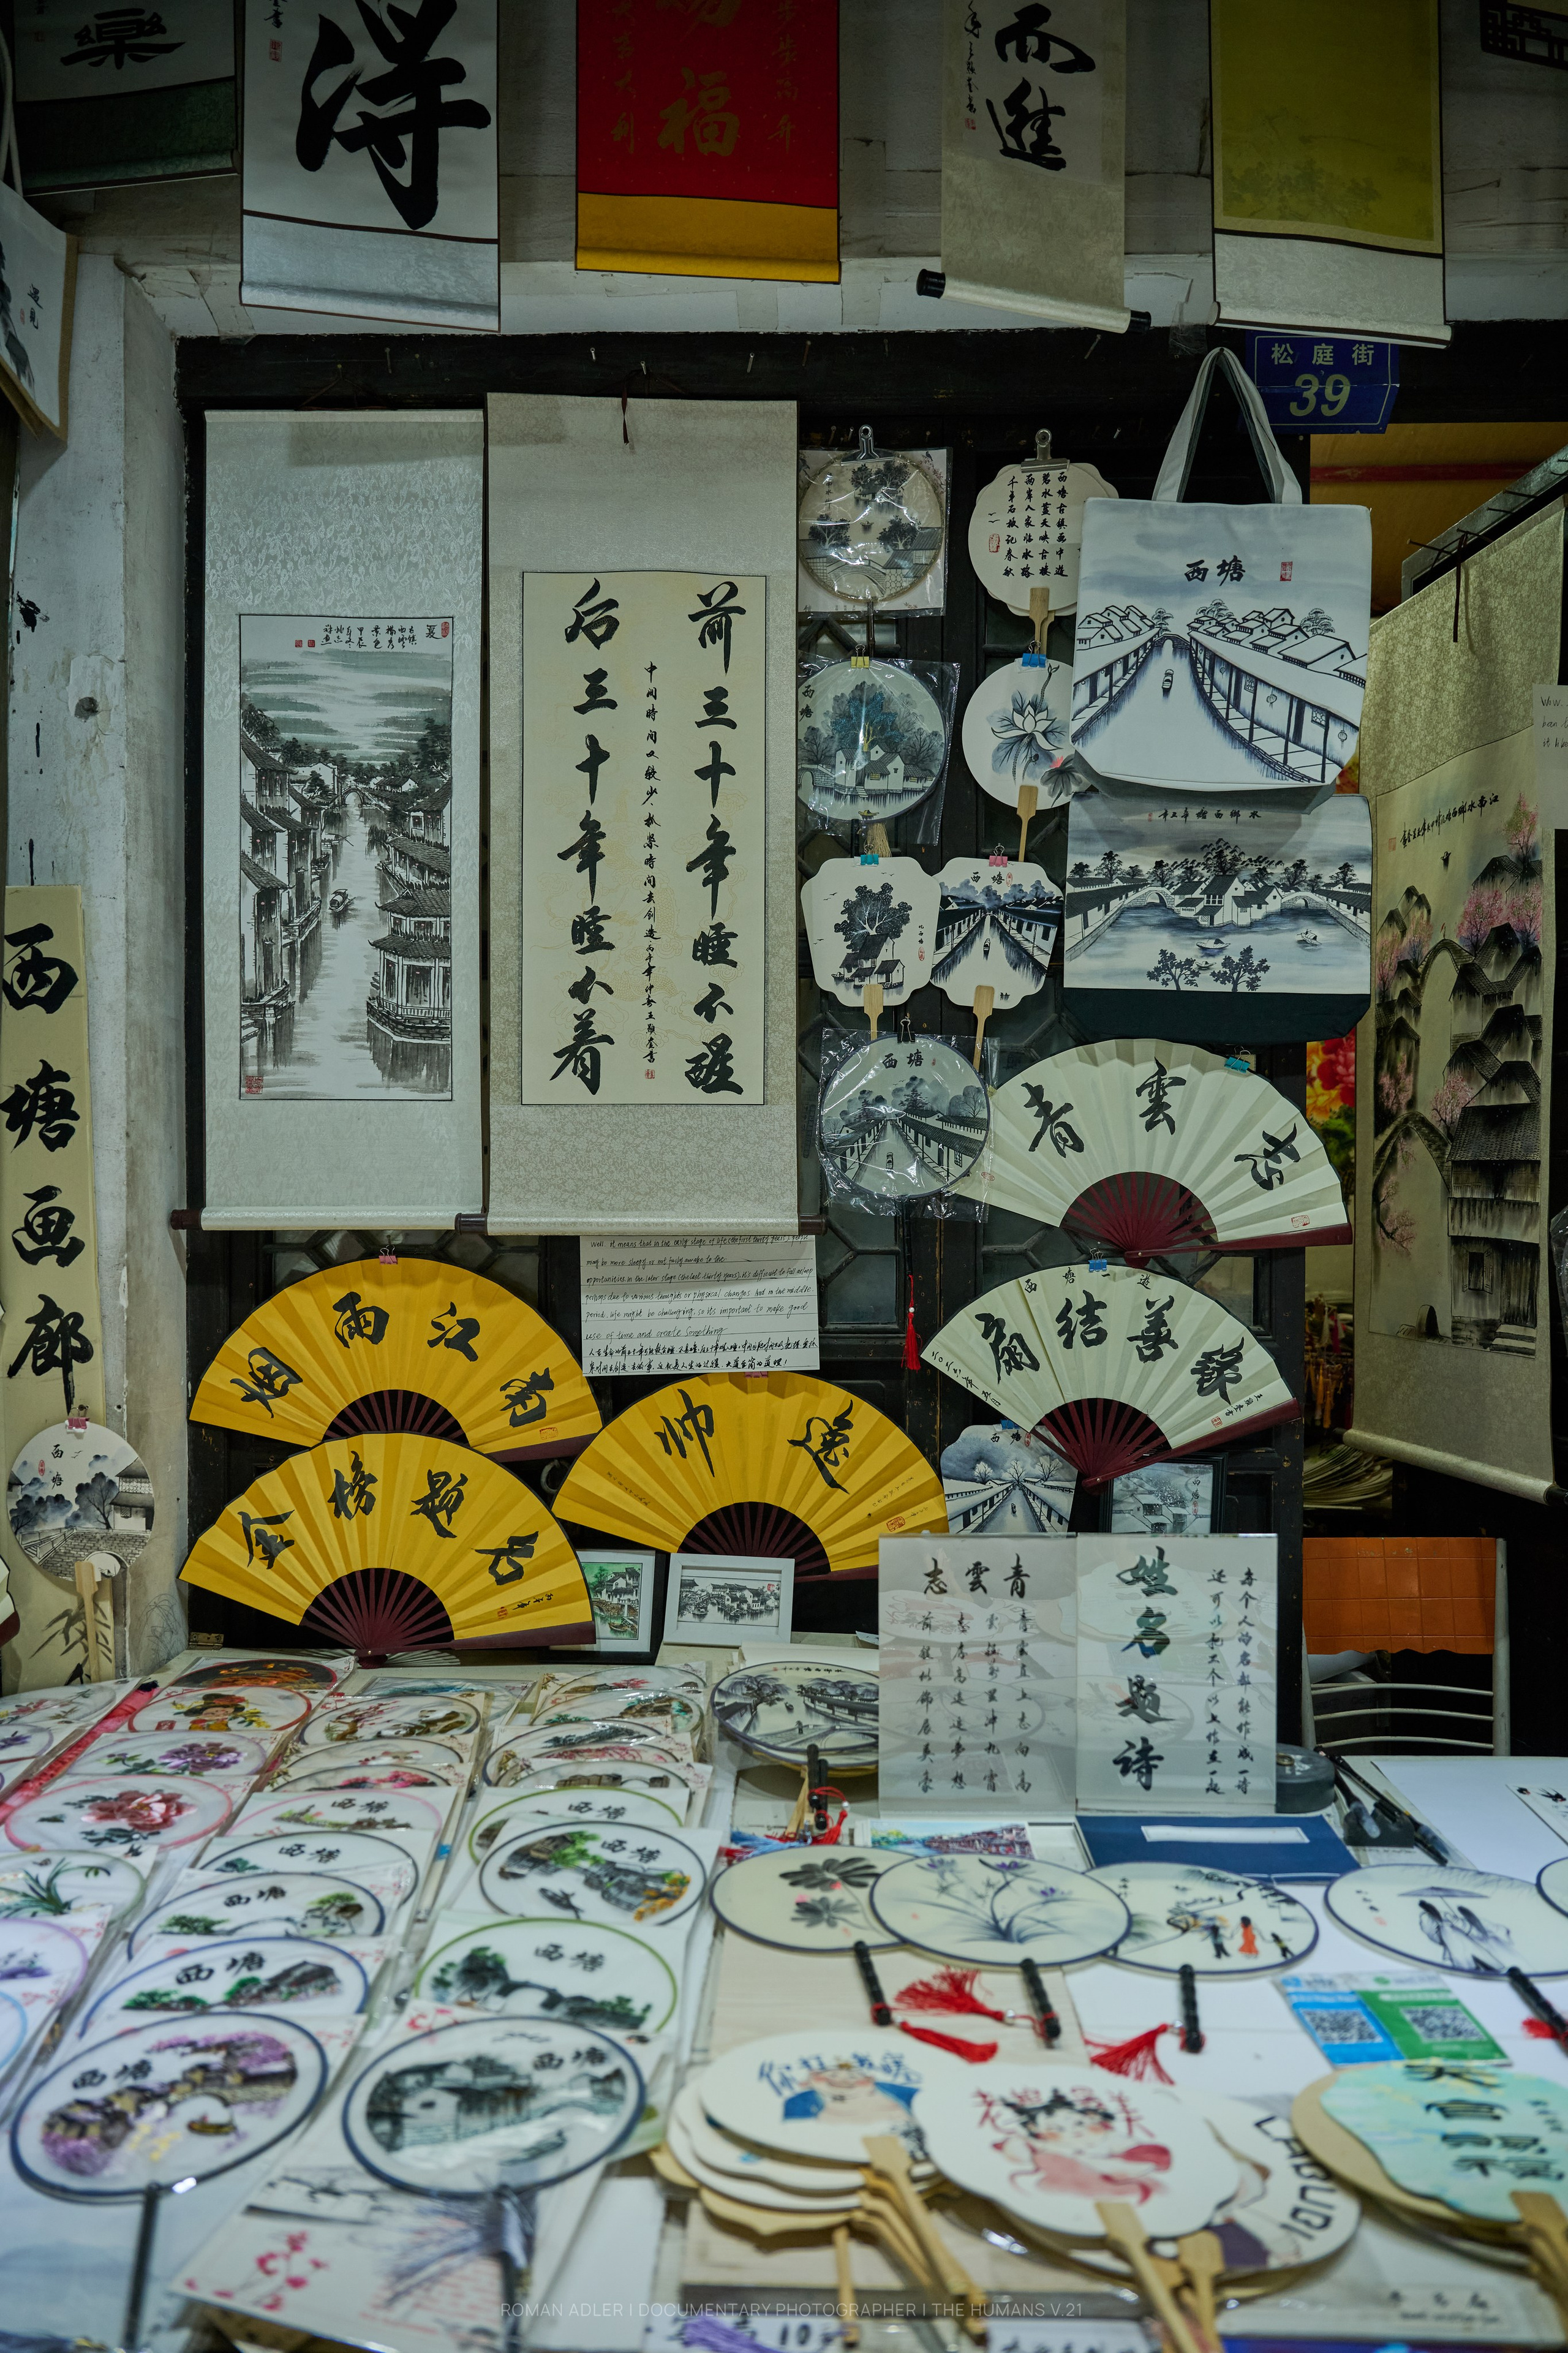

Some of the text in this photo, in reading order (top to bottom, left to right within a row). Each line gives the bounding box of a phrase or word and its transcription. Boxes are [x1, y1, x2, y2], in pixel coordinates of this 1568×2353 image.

[1271, 343, 1375, 366] 松庭街
[1289, 373, 1352, 417] 39
[1183, 555, 1246, 586] 西塘
[799, 684, 815, 723] 西塘
[549, 578, 620, 1097] 后三十年睡不着
[684, 581, 747, 1097] 前三十年睡不醒
[970, 871, 1005, 885] 西塘
[881, 1048, 925, 1070] 西塘
[1021, 1057, 1301, 1191] 青雲志
[674, 1237, 688, 1248] early
[690, 1237, 706, 1248] stage
[709, 1237, 715, 1246] of
[586, 1260, 599, 1269] may
[684, 1255, 704, 1264] awake
[706, 1255, 712, 1263] to
[661, 1274, 677, 1284] stage
[702, 1271, 723, 1282] thirty
[752, 1268, 778, 1282] difficult
[585, 1294, 607, 1305] perhaps
[607, 1292, 620, 1301] due
[622, 1292, 630, 1302] to
[655, 1291, 682, 1304] thoughts
[610, 1310, 621, 1321] life
[623, 1309, 643, 1322] might
[647, 1309, 655, 1317] be
[720, 1304, 753, 1319] important
[755, 1303, 764, 1312] to
[766, 1303, 785, 1314] make
[786, 1302, 809, 1319] good
[586, 1332, 602, 1340] use
[606, 1331, 614, 1343] of
[616, 1331, 635, 1340] time
[636, 1329, 652, 1339] and
[656, 1326, 682, 1337] create
[230, 1291, 555, 1429] 烟雨江南
[990, 1429, 1022, 1445] 西塘
[50, 1444, 64, 1490] 西塘
[1191, 1475, 1202, 1502] 西塘
[923, 1553, 1030, 1598] 青雲志
[175, 1951, 266, 1985] 西塘
[73, 2059, 153, 2090] 西塘
